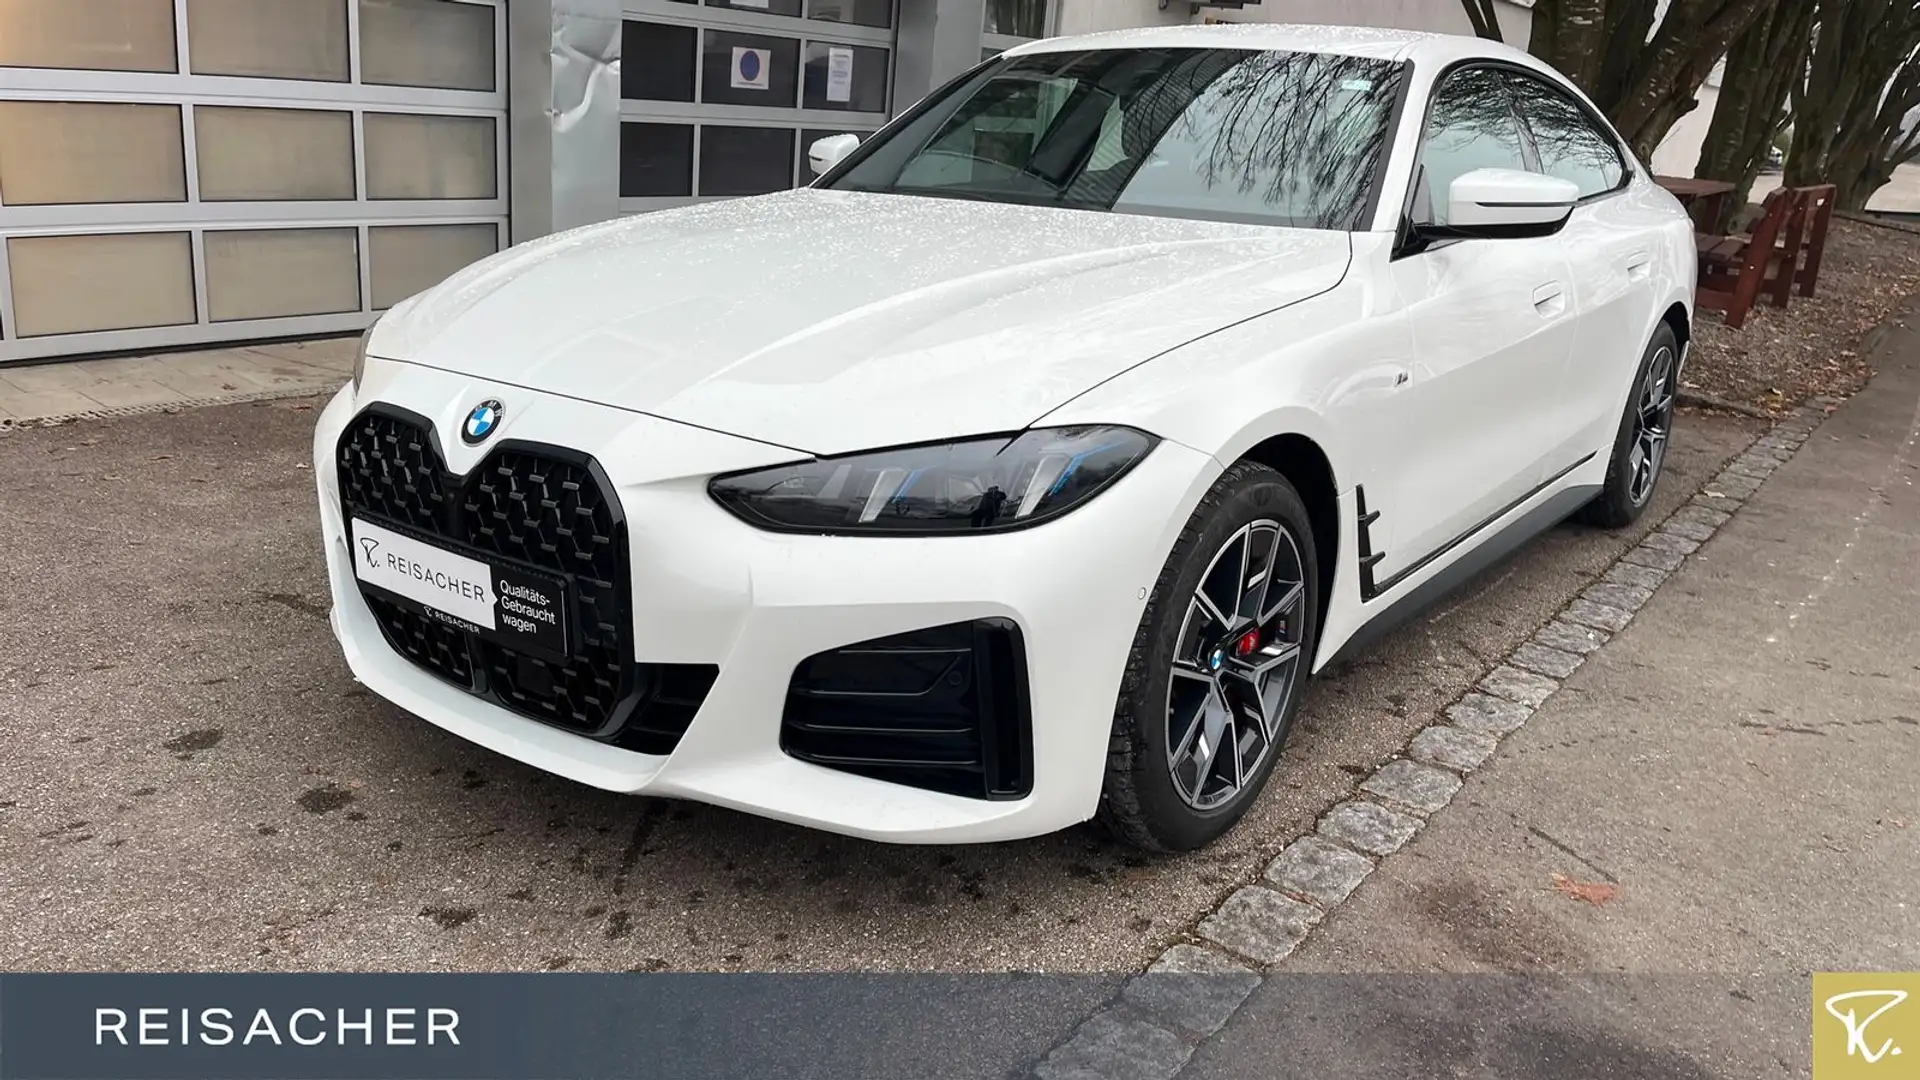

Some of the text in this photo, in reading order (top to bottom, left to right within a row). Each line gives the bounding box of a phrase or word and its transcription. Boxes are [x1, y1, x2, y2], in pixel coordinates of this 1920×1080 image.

[387, 552, 485, 603] REISACHER
[500, 580, 550, 606] Qualitäts-
[501, 596, 556, 625] Gebraucht
[502, 613, 537, 633] wagen
